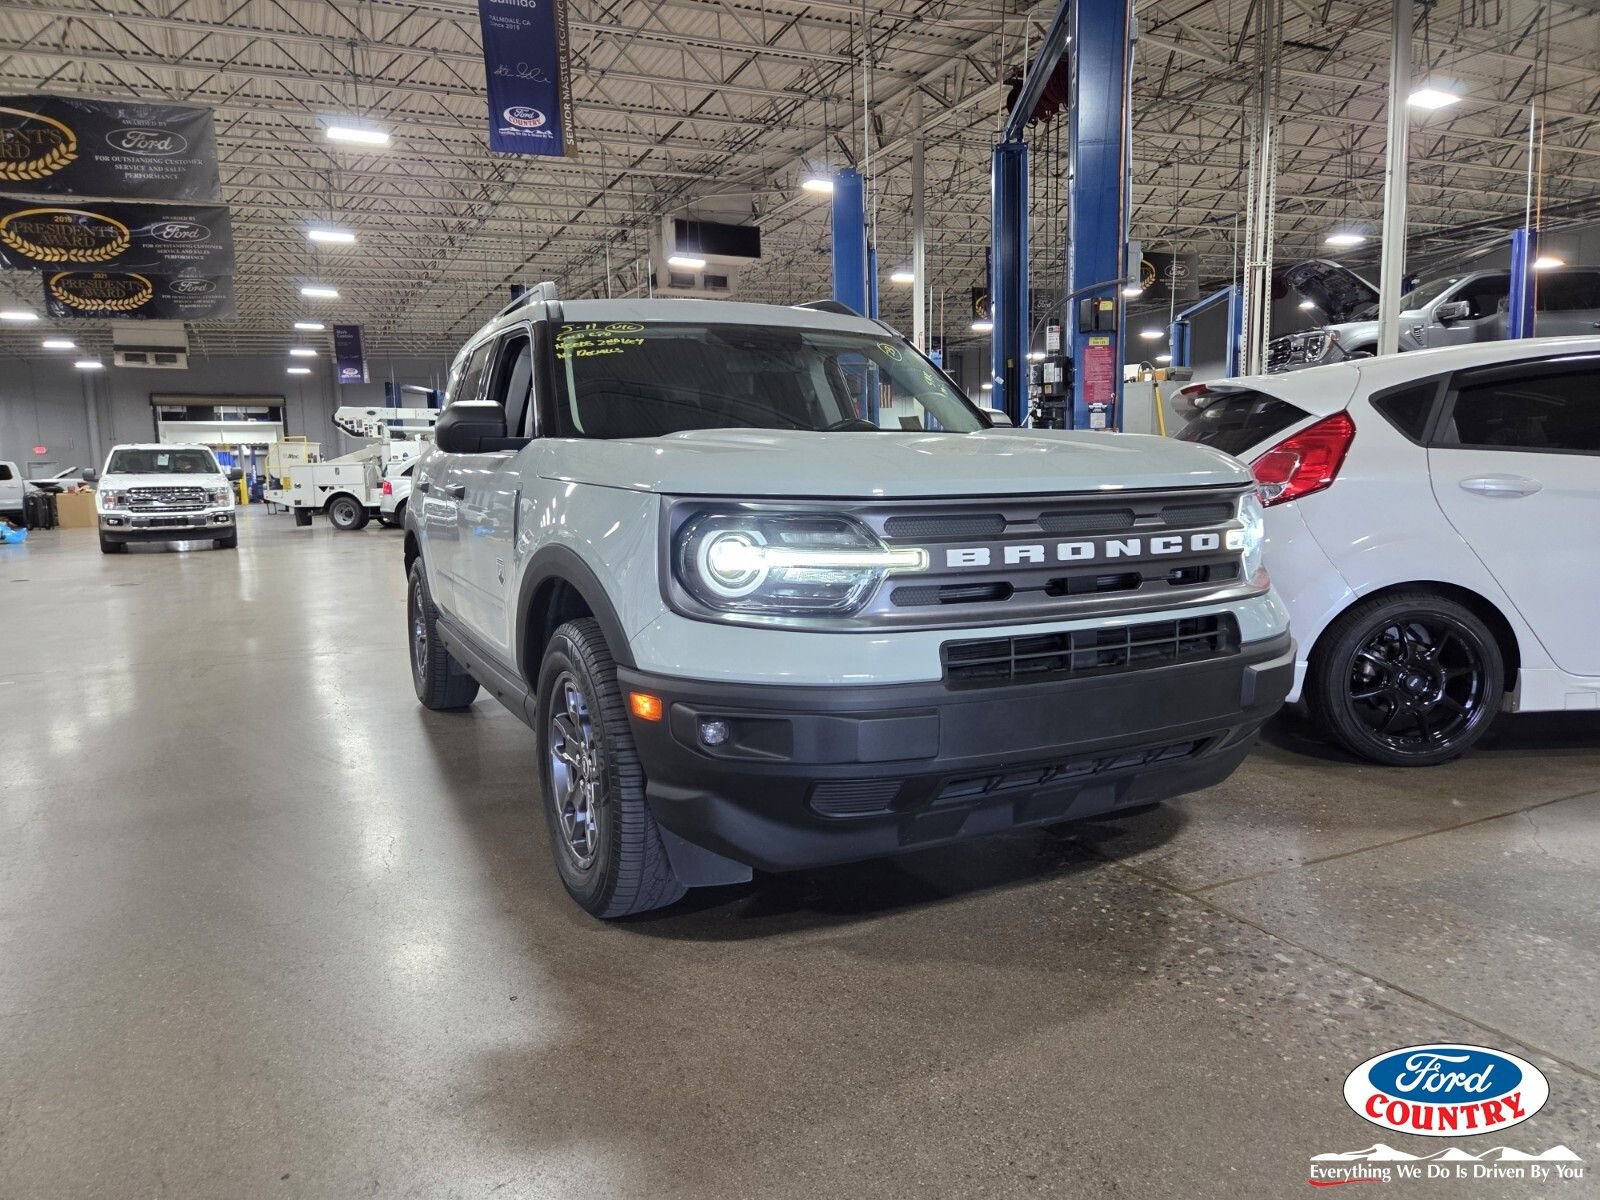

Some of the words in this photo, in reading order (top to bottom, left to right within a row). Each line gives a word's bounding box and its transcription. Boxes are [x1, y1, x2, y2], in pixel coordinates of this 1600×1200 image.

[560, 55, 571, 100] MASTER
[514, 109, 535, 118] Ford
[508, 116, 542, 126] COUNTRY
[563, 103, 575, 145] SENIOR
[121, 130, 174, 151] Ford
[94, 154, 110, 162] FOR
[111, 155, 163, 165] OUTSTANDING
[164, 158, 203, 166] CUSTOMER
[124, 172, 179, 180] PERFORMANCE
[13, 221, 120, 238] PRESIDENT'S
[162, 224, 201, 239] Ford
[38, 233, 97, 248] AWARD
[61, 278, 145, 291] PRESIDENT'S
[178, 280, 208, 292] Ford
[81, 288, 127, 299] AWARD
[946, 533, 1220, 568] BRONCO
